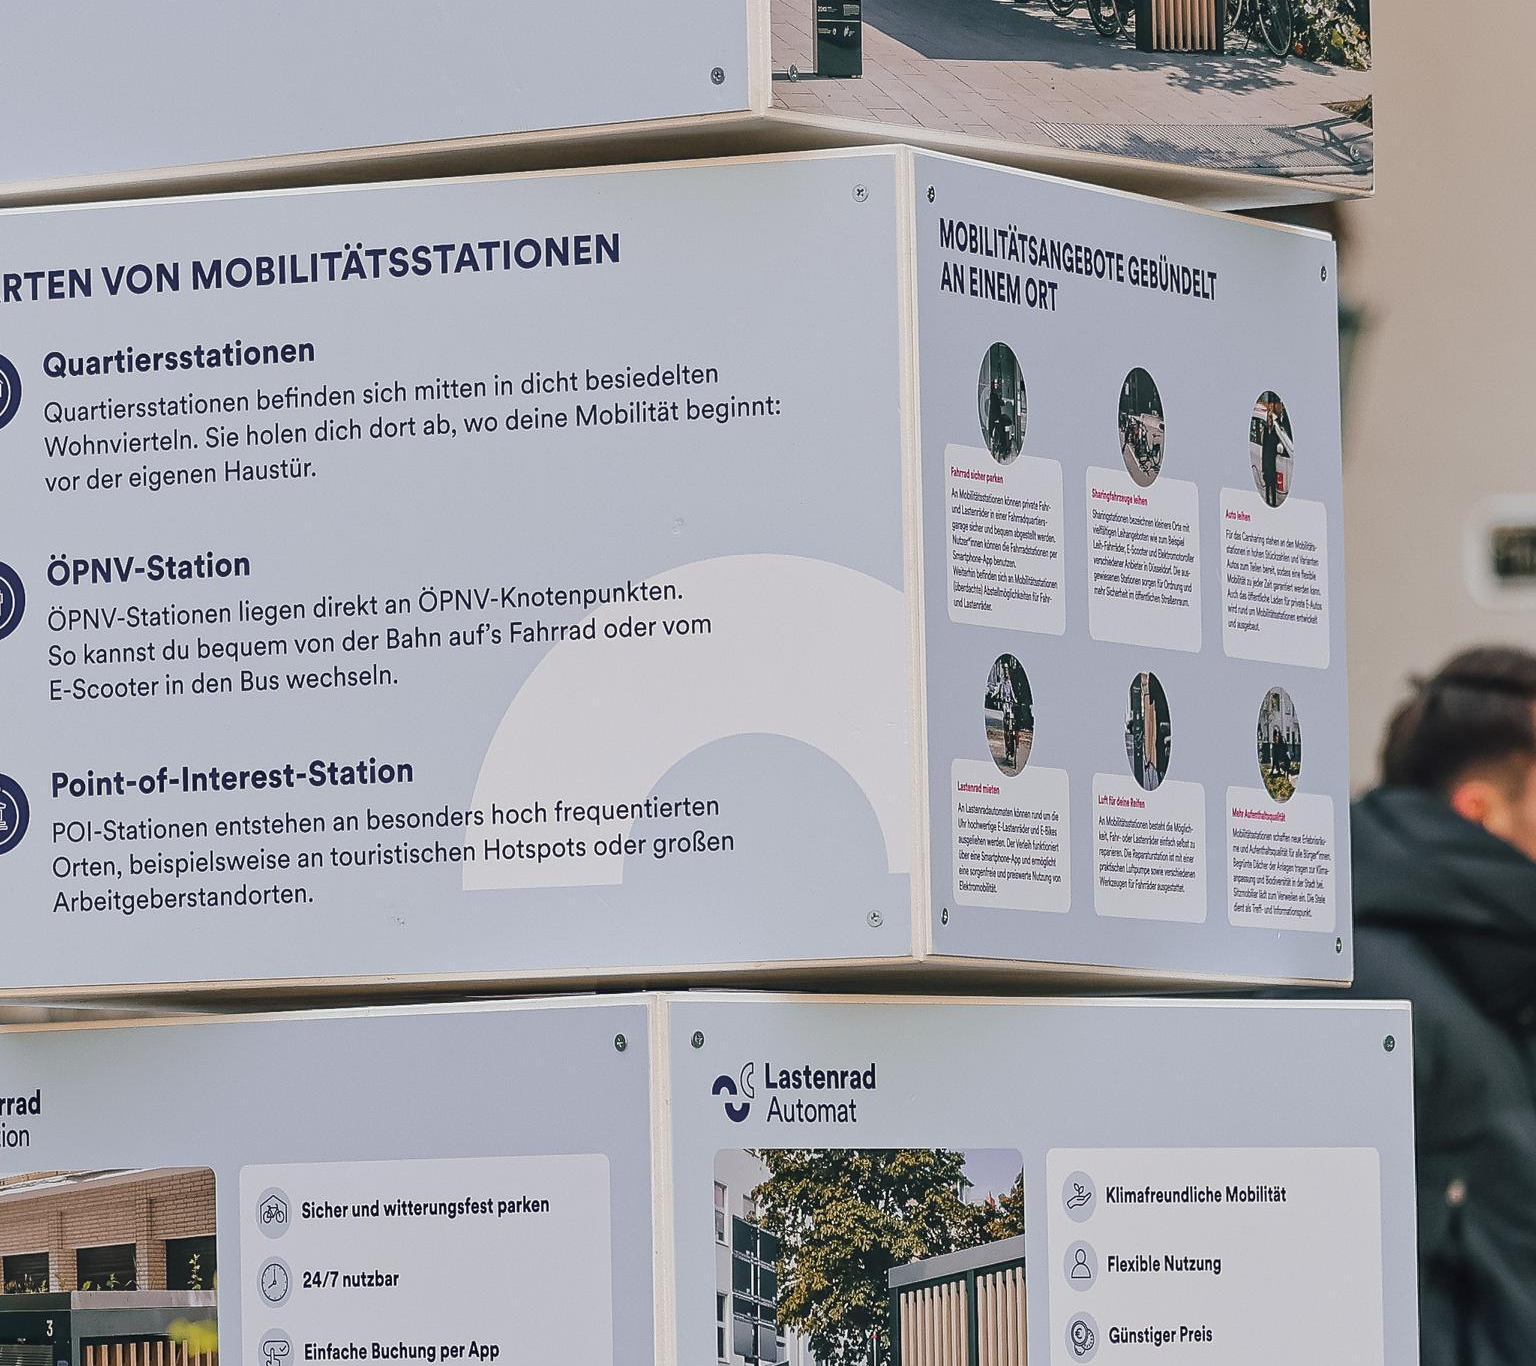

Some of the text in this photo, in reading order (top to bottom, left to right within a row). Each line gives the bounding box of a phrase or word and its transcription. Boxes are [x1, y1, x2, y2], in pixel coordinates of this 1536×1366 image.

[101, 262, 179, 296] VON
[192, 233, 619, 290] MOBILITÄTSSTATIONEN
[939, 217, 1217, 301] MOBILITÄTSANGEBOTE GEBÜNDELT
[940, 261, 1058, 311] AN EINEM ORT
[43, 339, 314, 378] Quartiersstationen
[44, 363, 718, 423] Quartiersstationen befinden sich mitten in dicht besiedelten
[44, 395, 780, 457] Wohnvierteln. Sie holen dich dort ab, wo deine Mobilität beginnt:
[44, 457, 316, 492] vor der eigenen Haustür.
[47, 551, 250, 586] ÖPNV-Station
[48, 580, 682, 631] ÖPNV-Stationen liegen direkt an ÖPNV-Knotenpunkten.
[48, 644, 76, 666] So
[84, 642, 155, 664] kannst
[162, 638, 189, 660] du
[197, 637, 287, 662] bequem
[294, 637, 334, 654] von
[342, 629, 379, 652] der
[386, 626, 441, 649] Bahn
[510, 617, 595, 643] Fahrrad
[604, 615, 656, 638] oder
[662, 618, 711, 635] vom
[50, 663, 397, 700] E-Scooter in den Bus wechseln.
[52, 757, 413, 798] Point-of-Interest-Station
[52, 795, 719, 843] POI-Stationen entstehen an besonders hoch frequentierten
[52, 829, 733, 880] Orten, beispielsweise an touristischen Hotspots oder großen
[52, 883, 313, 915] Arbeitgeberstandorten.
[765, 1062, 876, 1089] Lastenrad
[766, 1097, 857, 1123] Automat
[301, 1195, 549, 1219] Sicher und witterungsfest parken
[1106, 1185, 1286, 1203] Klimafreundliche Mobilität
[303, 1269, 399, 1288] 24/7 nutzbar
[1107, 1254, 1221, 1275] Flexible Nutzung
[46, 1319, 53, 1336] 3
[1108, 1324, 1212, 1347] Günstiger Preis
[304, 1340, 499, 1362] Einfache Buchung per App
